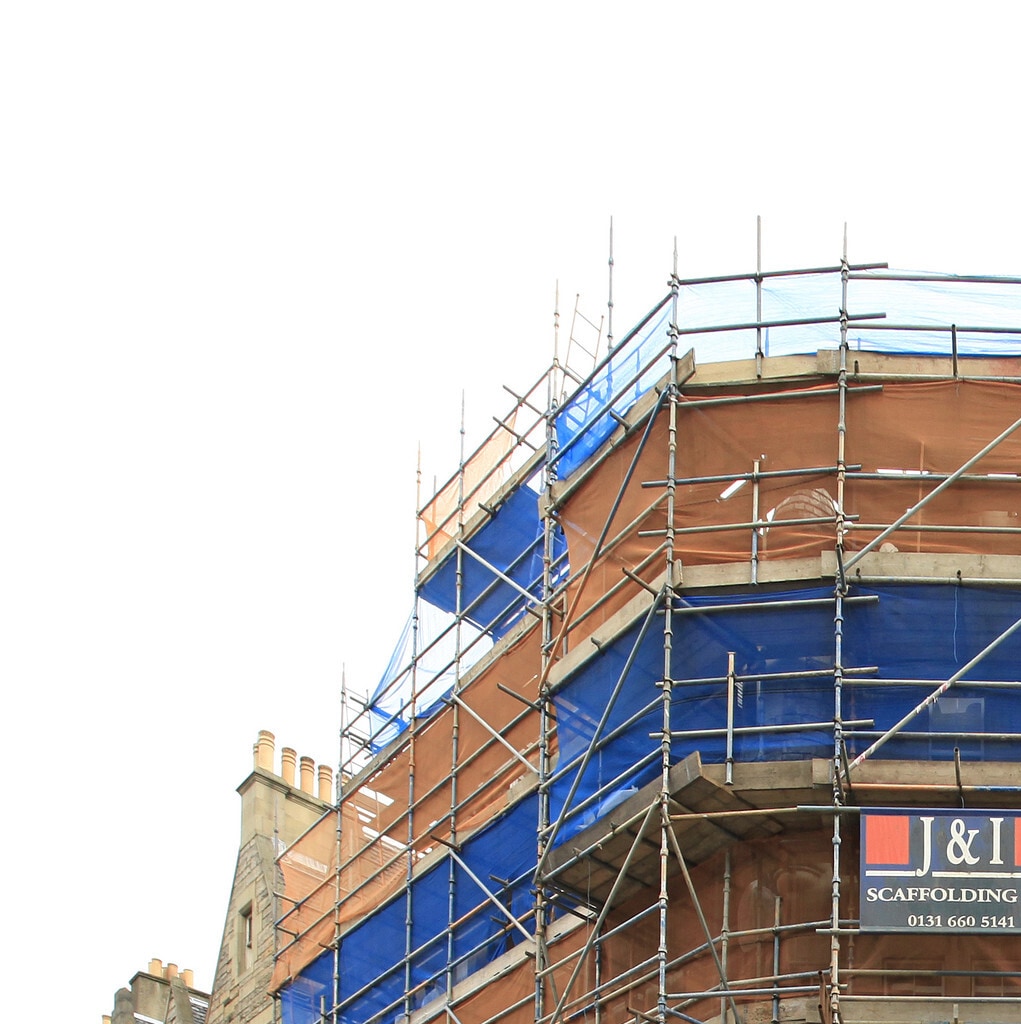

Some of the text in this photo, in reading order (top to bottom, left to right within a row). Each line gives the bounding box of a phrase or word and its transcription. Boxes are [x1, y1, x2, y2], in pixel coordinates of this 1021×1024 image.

[866, 887, 1018, 903] SCAFFOLDING
[907, 914, 1015, 929] 0131 660 5141
